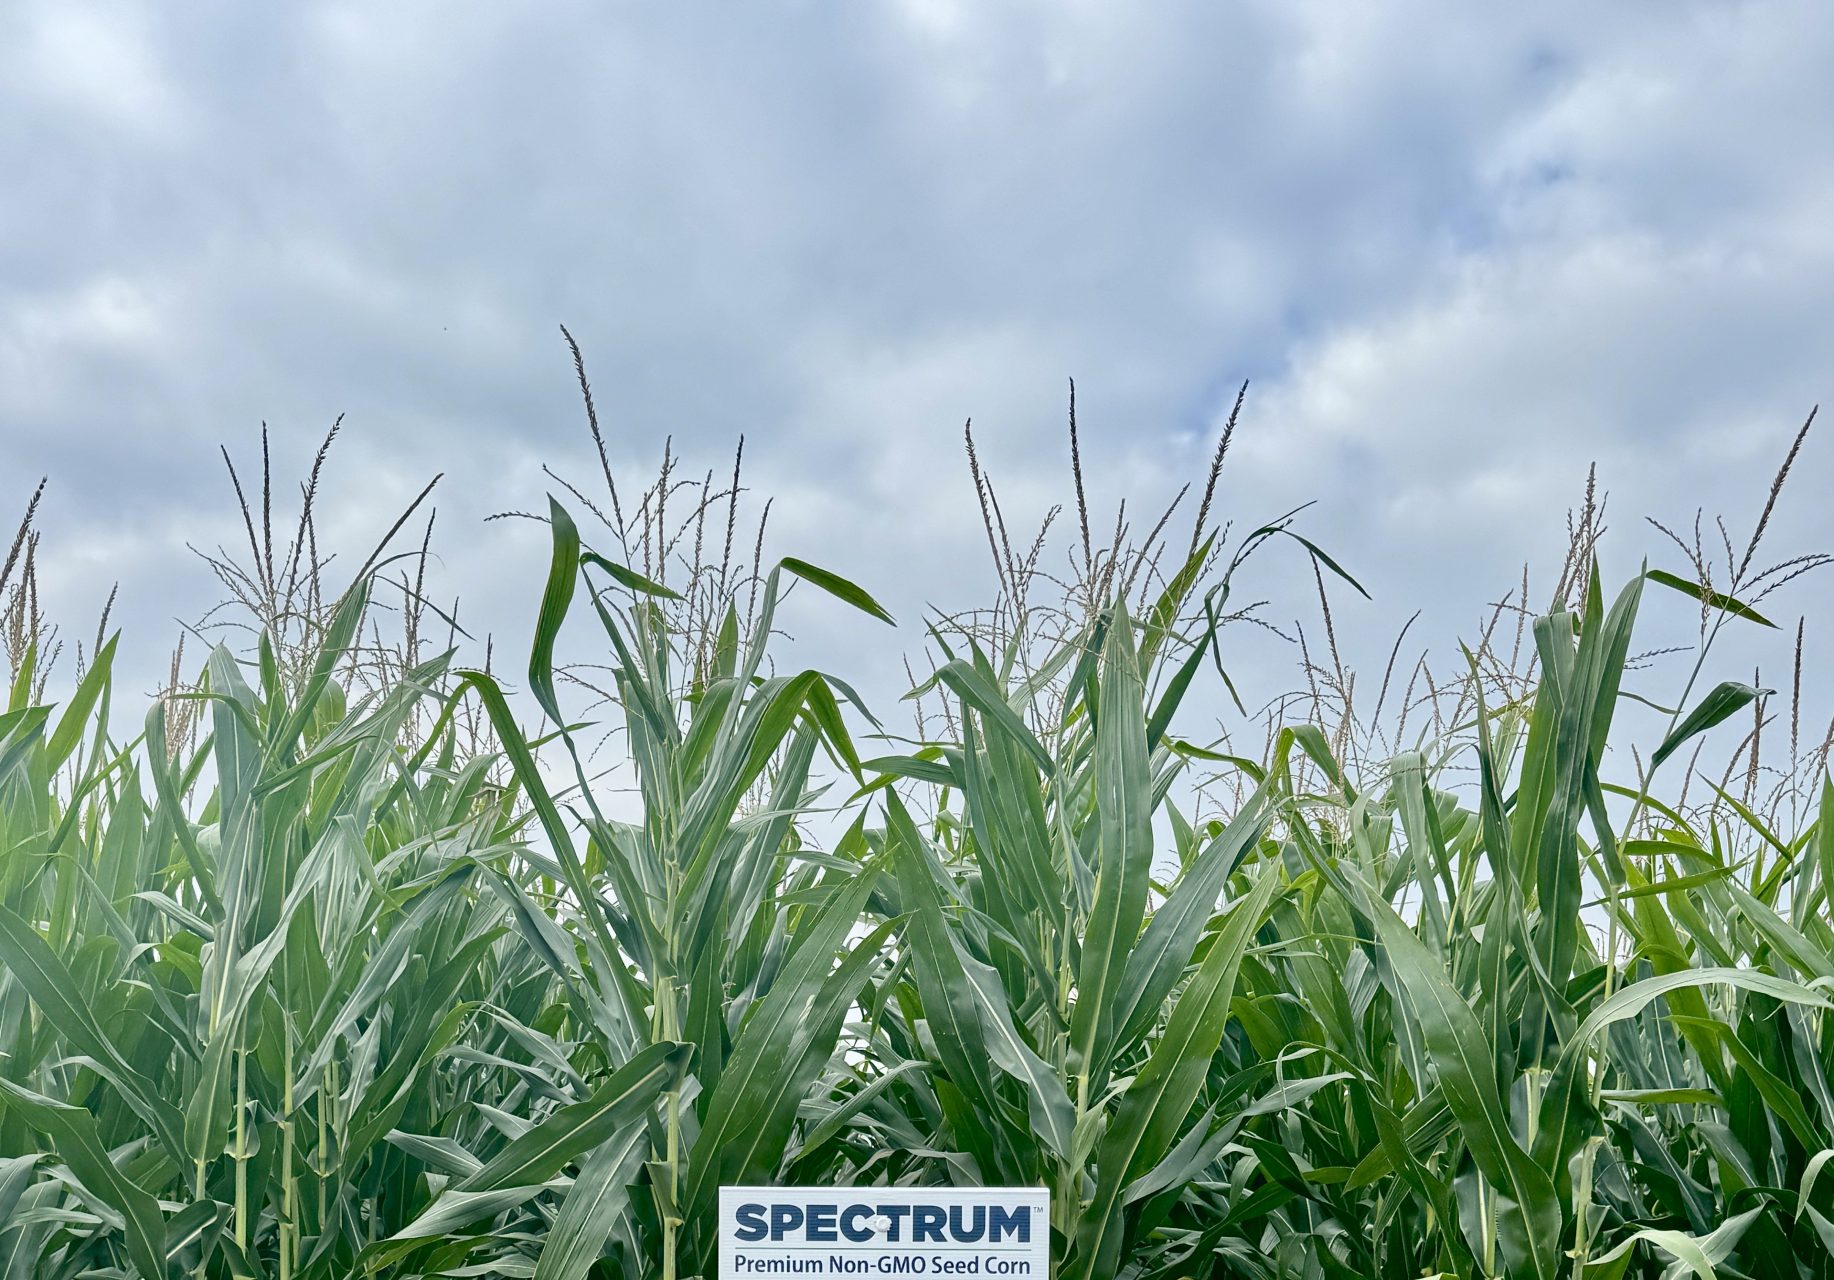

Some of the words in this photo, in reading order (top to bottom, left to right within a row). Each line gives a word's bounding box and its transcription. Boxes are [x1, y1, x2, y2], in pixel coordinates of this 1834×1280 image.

[733, 1203, 1031, 1243] SPECTRUM
[734, 1254, 824, 1273] Premium
[829, 1255, 926, 1274] Non-GMO
[932, 1256, 979, 1275] Seed
[984, 1257, 1031, 1275] Corn
